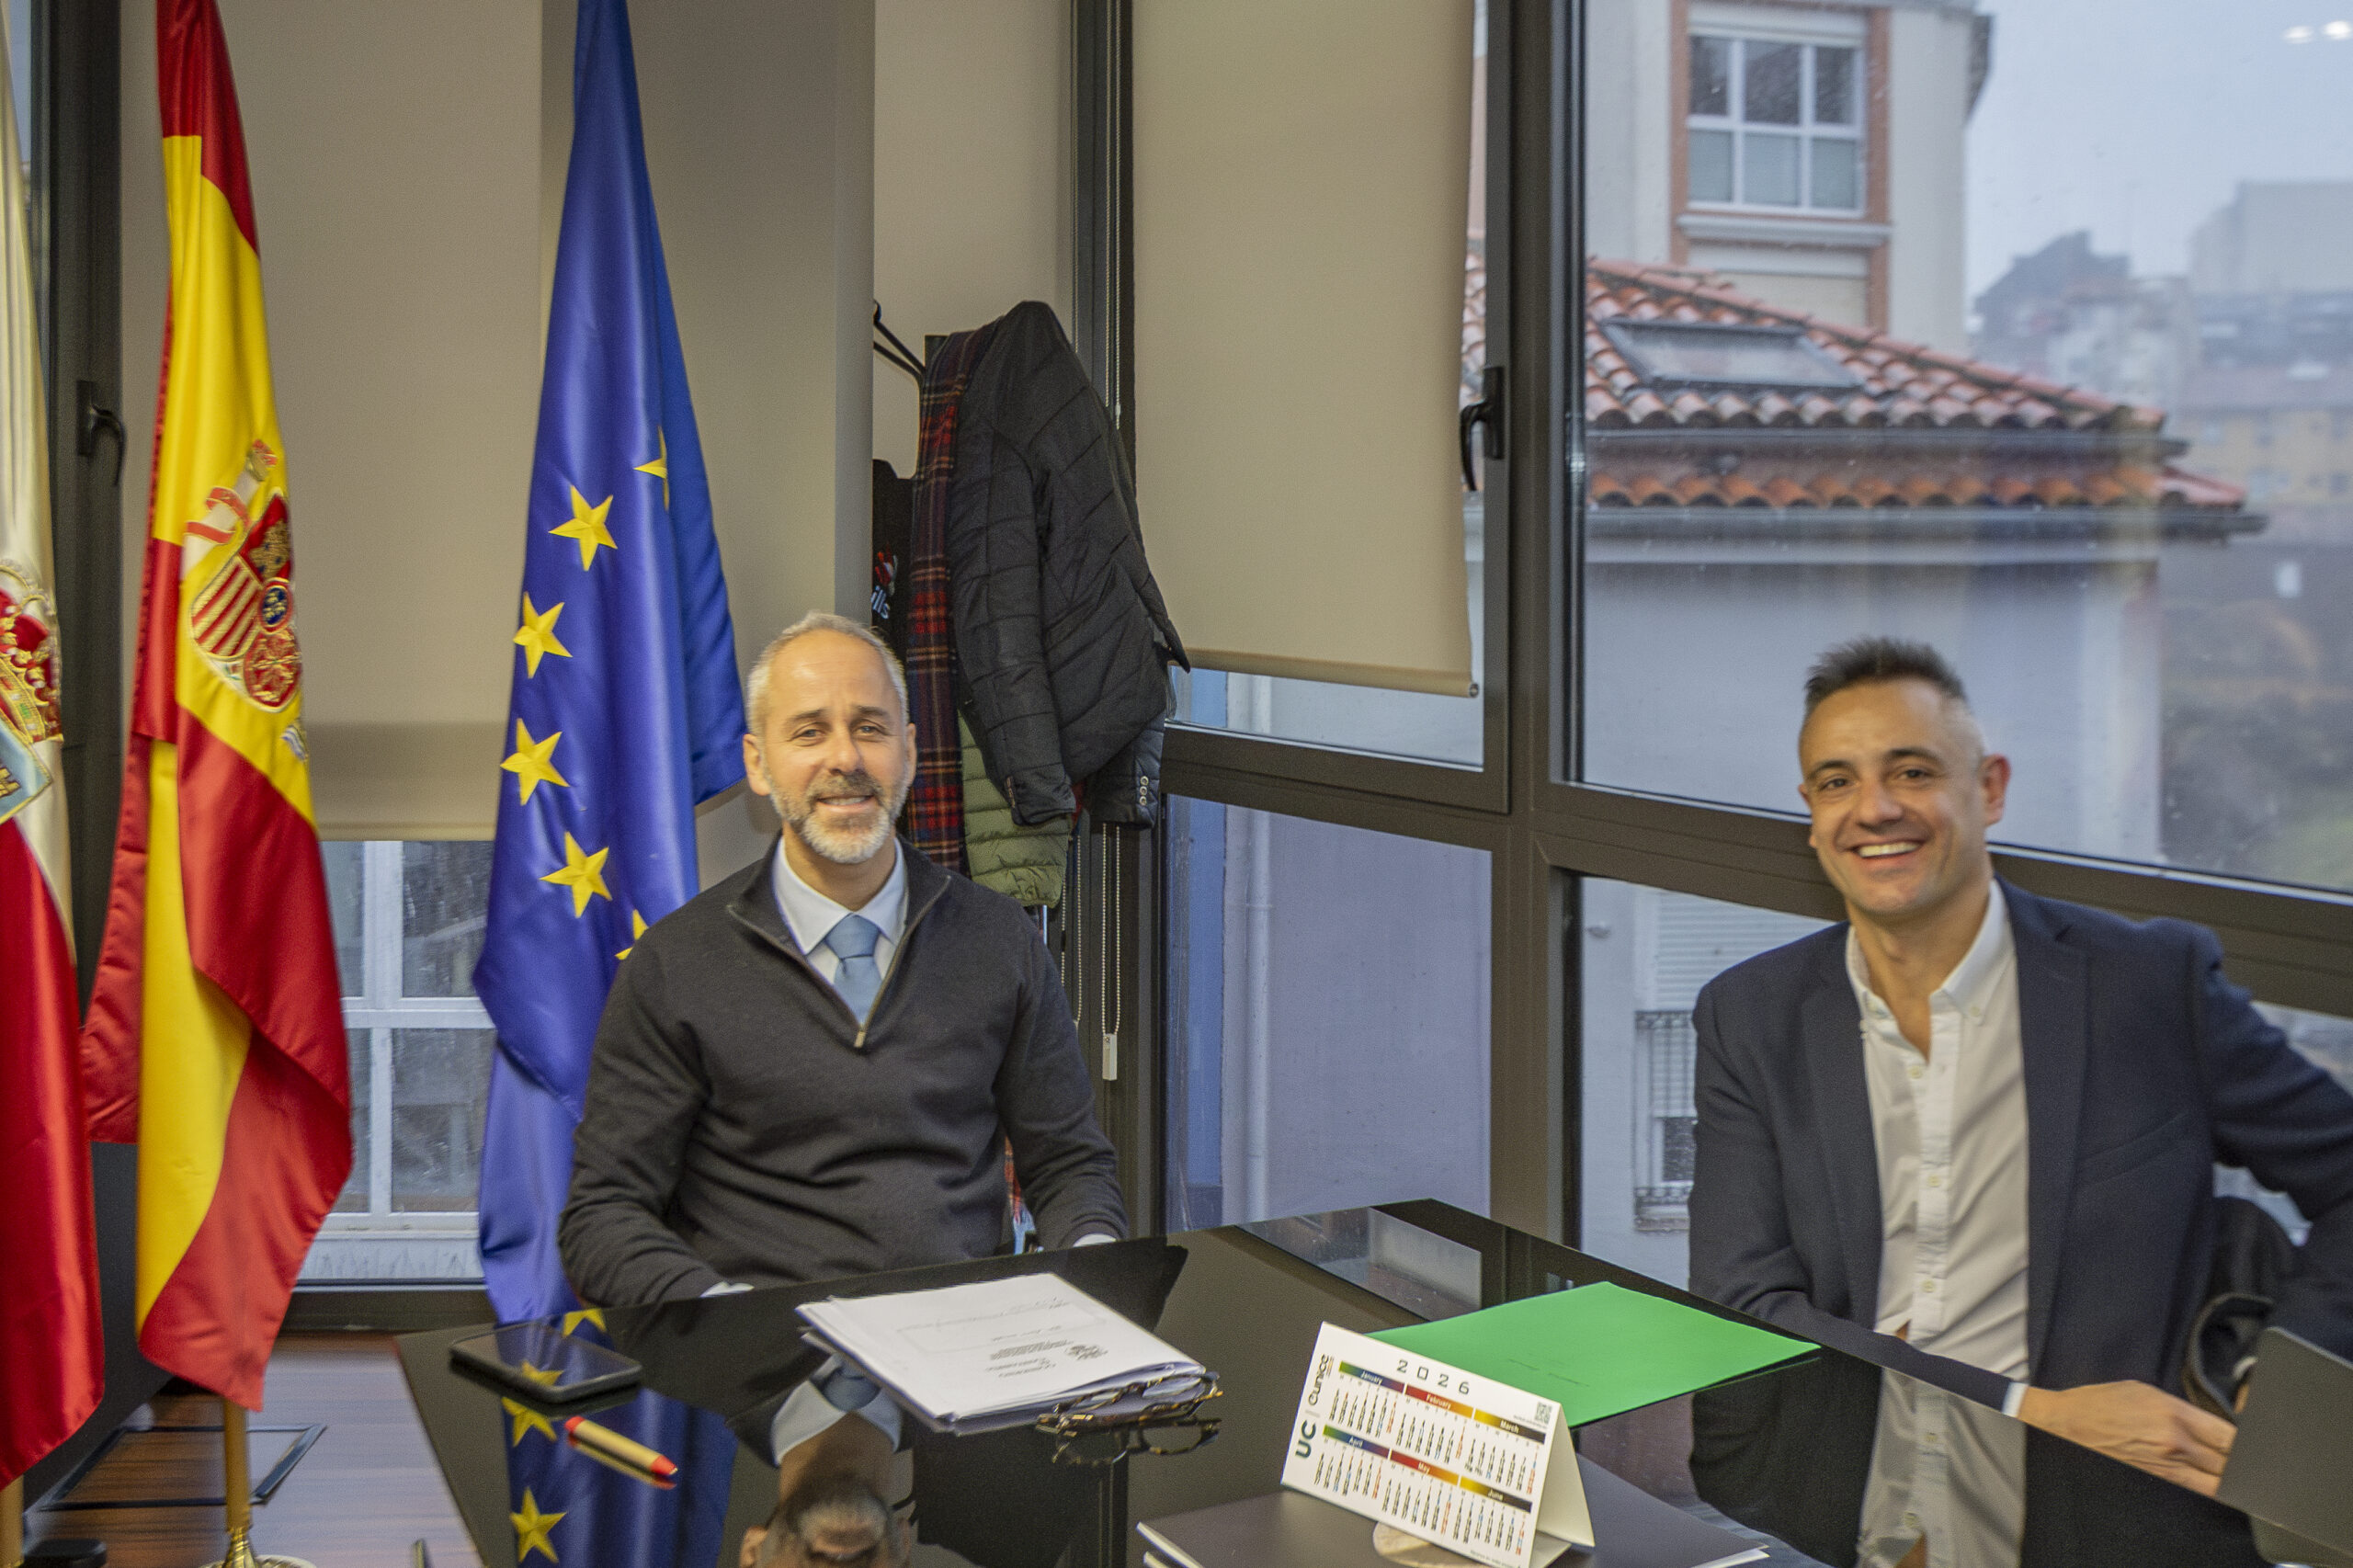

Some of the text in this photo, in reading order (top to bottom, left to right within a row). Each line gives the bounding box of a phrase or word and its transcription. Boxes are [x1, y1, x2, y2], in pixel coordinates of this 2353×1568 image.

[1360, 1370, 1383, 1386] January
[1396, 1359, 1471, 1395] 2026
[1426, 1393, 1451, 1410] February
[1499, 1420, 1520, 1434] March
[1295, 1419, 1316, 1459] UC
[1487, 1488, 1504, 1501] June
